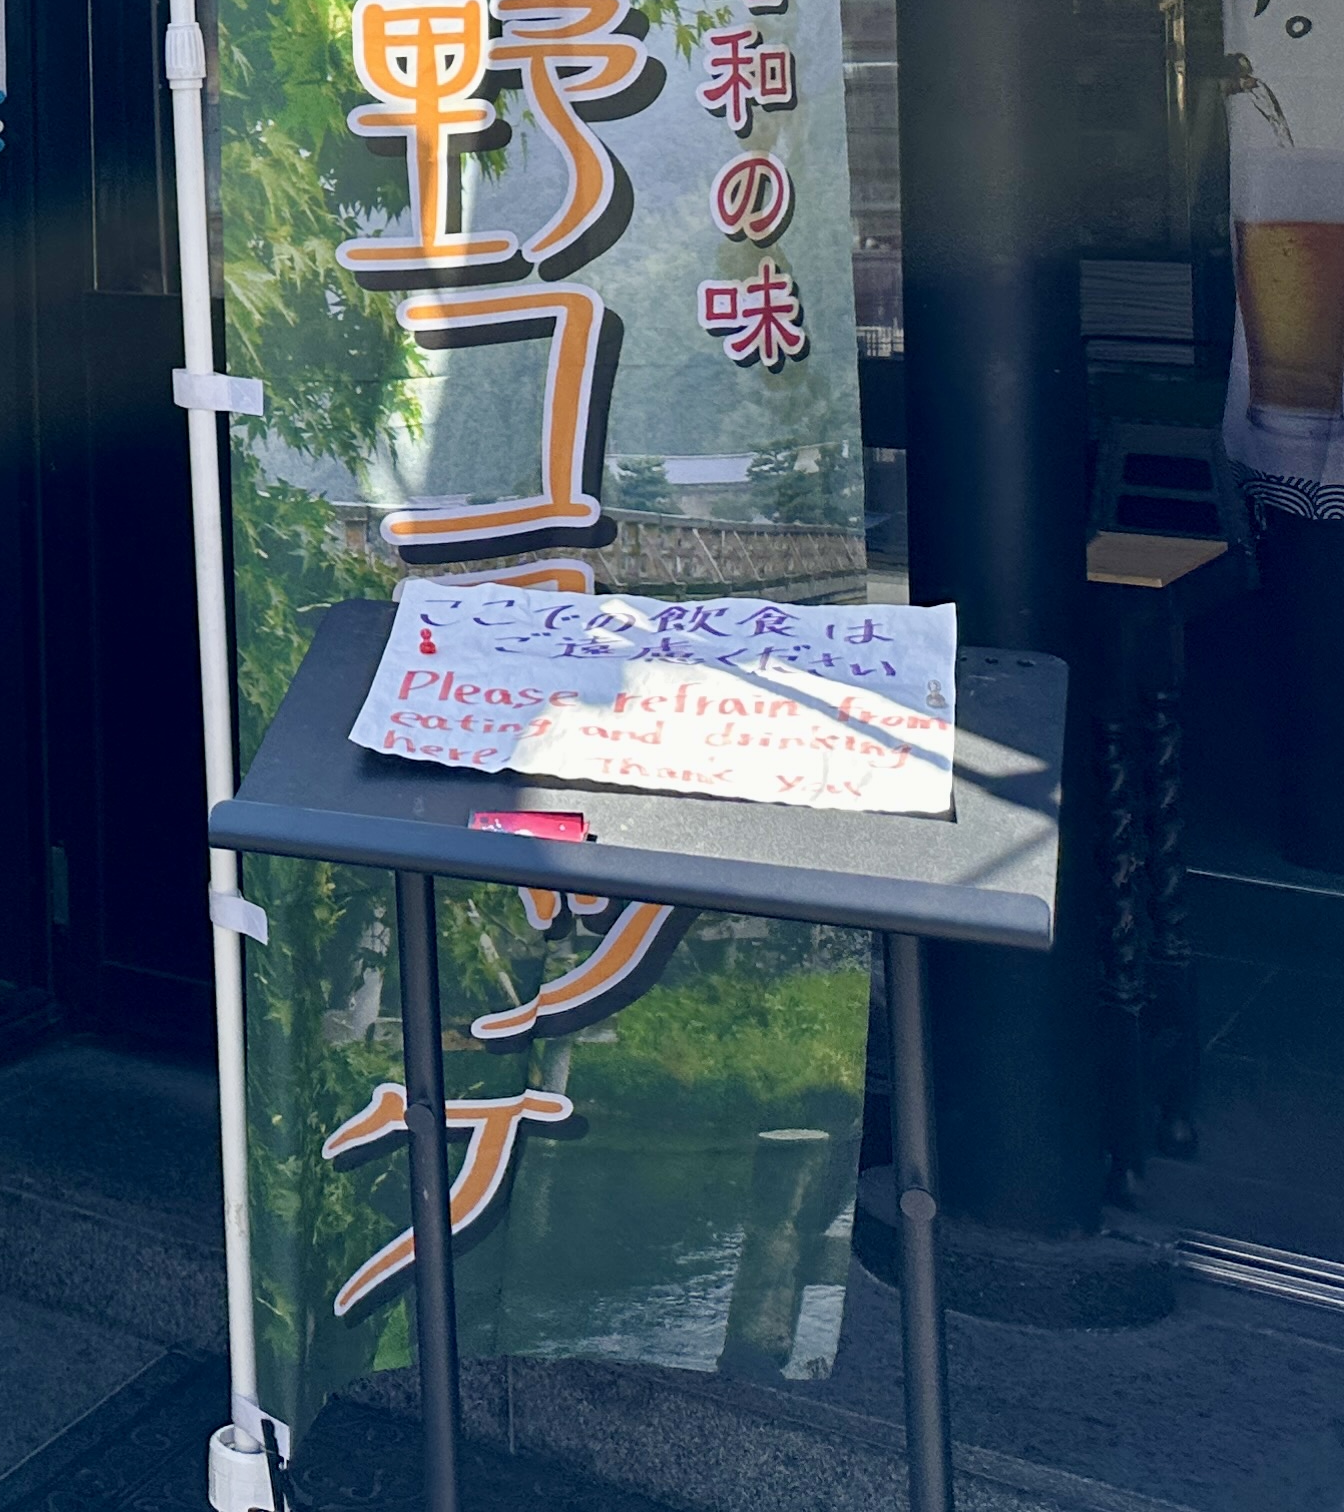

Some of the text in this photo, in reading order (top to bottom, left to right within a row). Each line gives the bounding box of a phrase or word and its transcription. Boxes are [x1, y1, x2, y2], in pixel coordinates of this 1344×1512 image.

[420, 598, 895, 646] ここでの飲食は
[494, 630, 897, 678] ご遠慮ください
[398, 669, 952, 731] Please refrain from
[390, 709, 914, 770] eating and drinking
